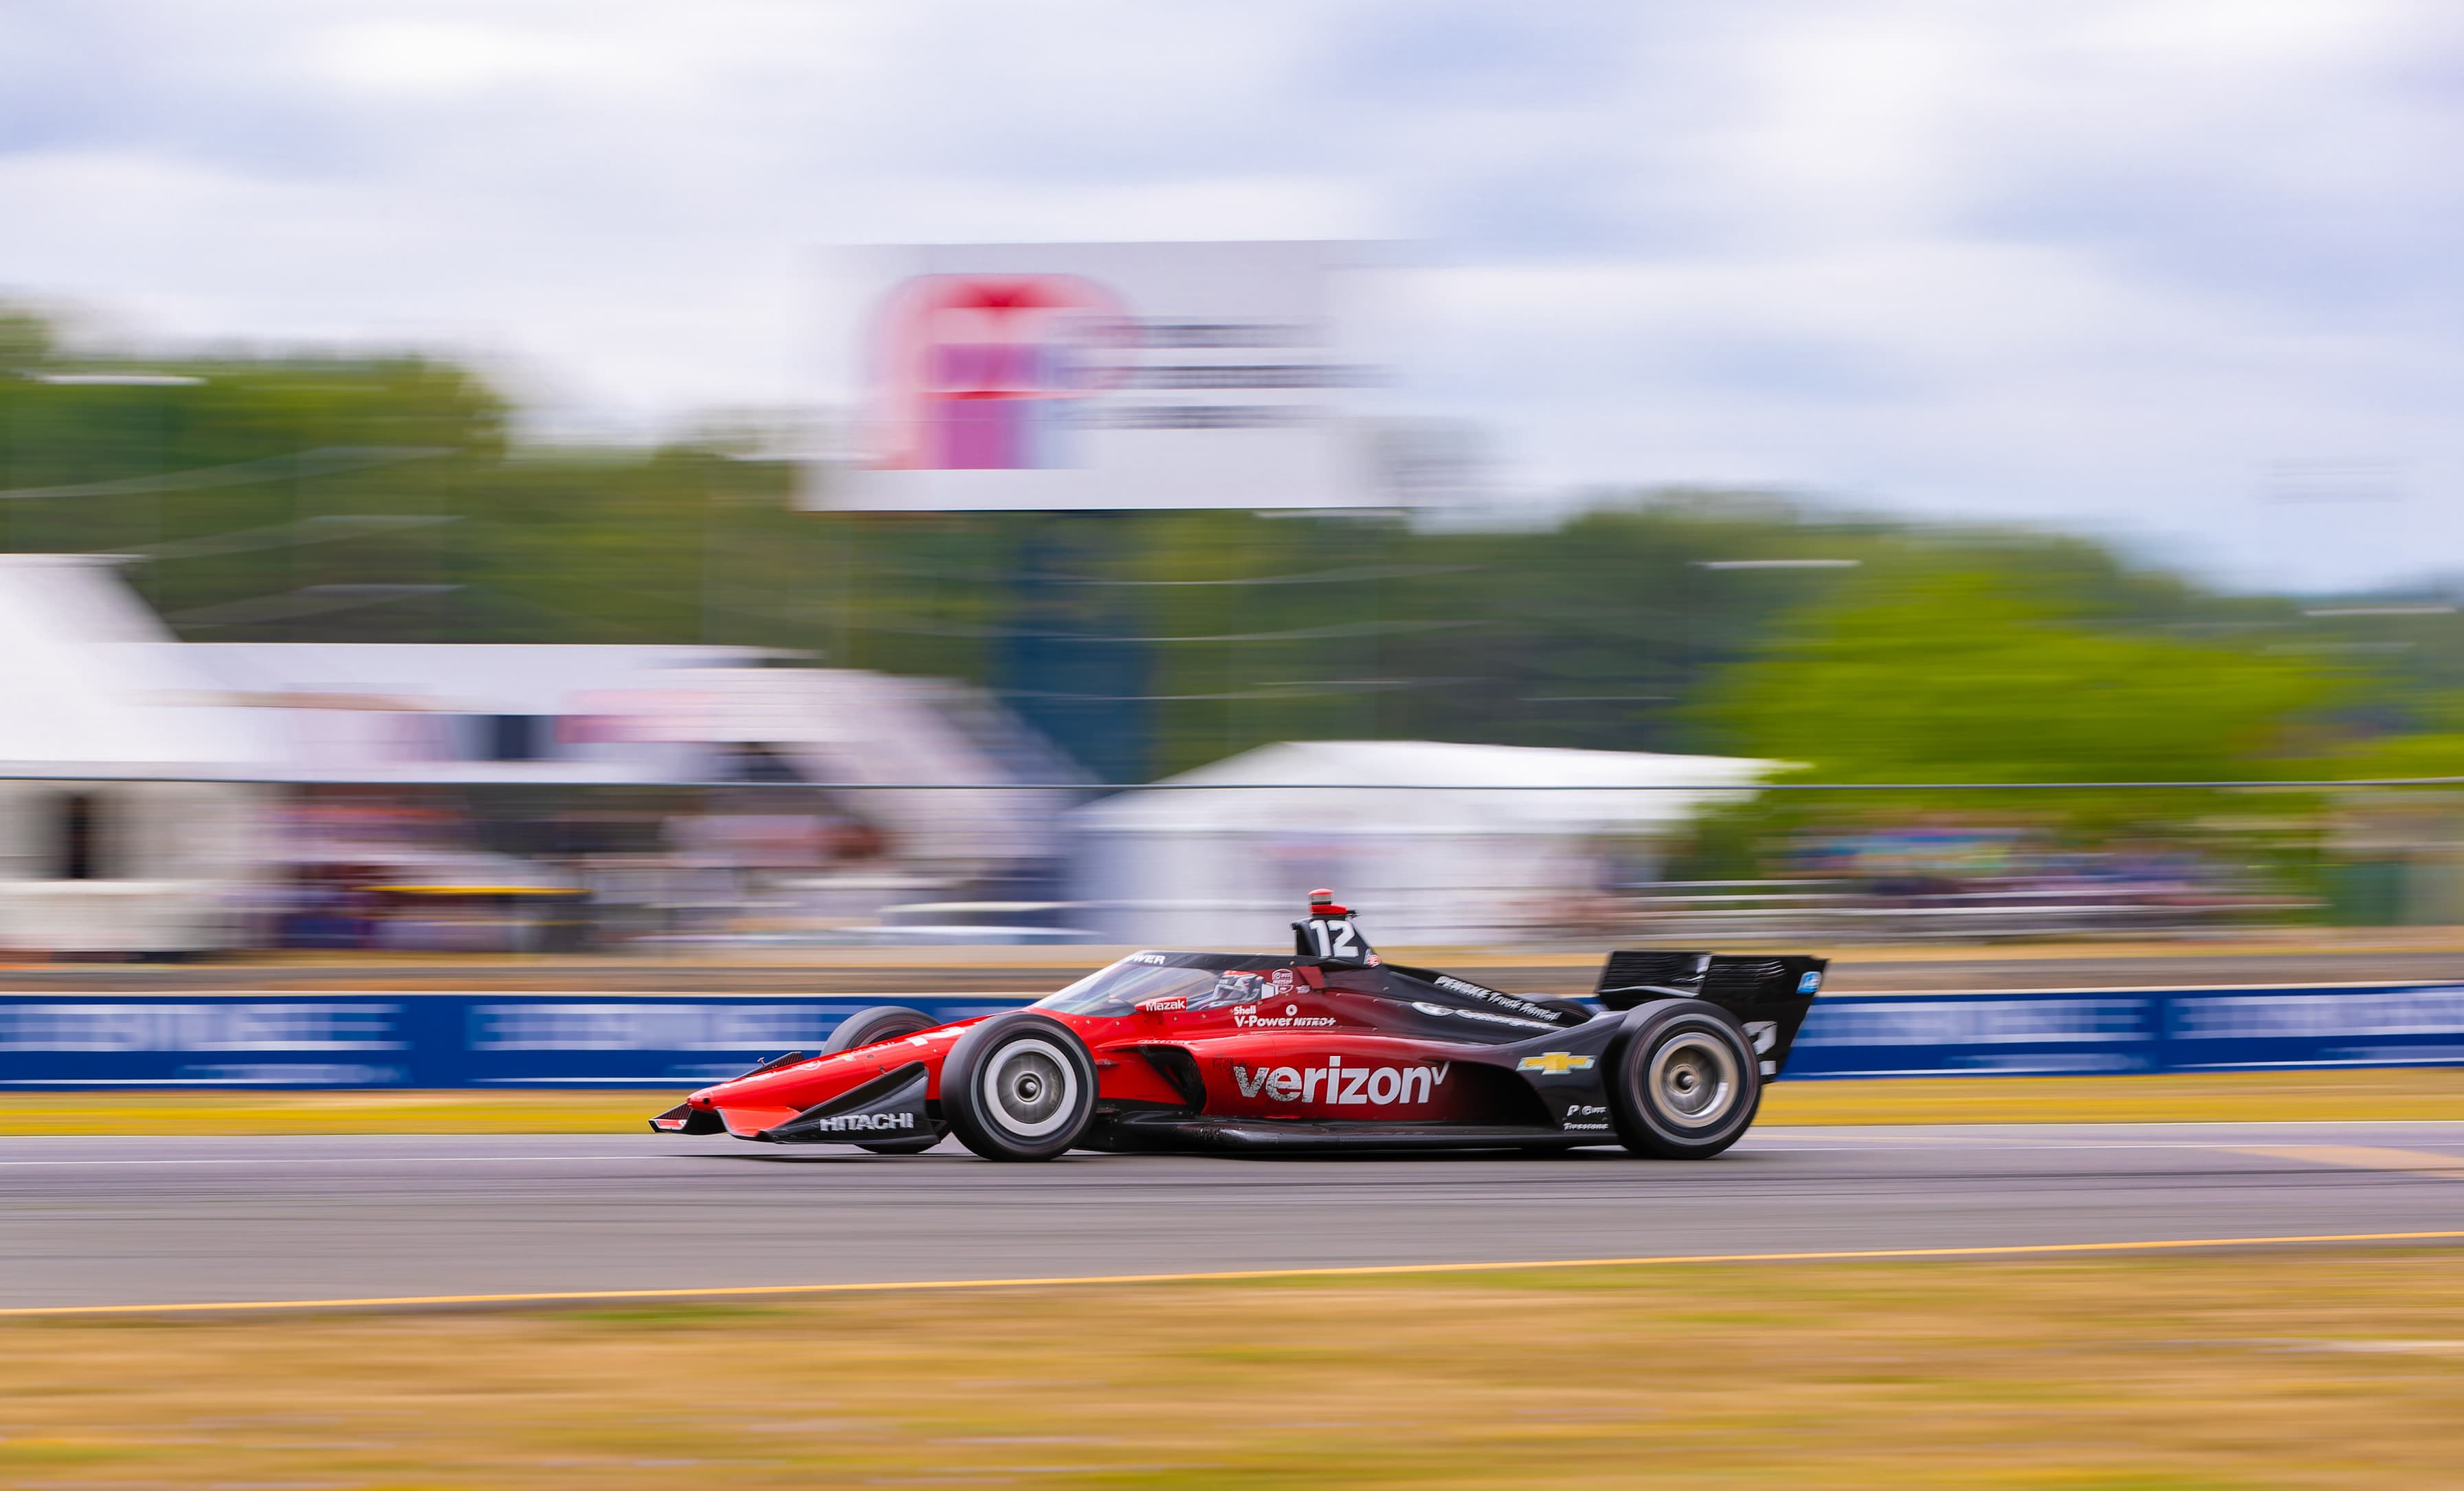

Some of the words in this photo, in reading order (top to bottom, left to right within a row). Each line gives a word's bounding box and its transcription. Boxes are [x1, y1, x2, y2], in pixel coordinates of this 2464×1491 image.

[1309, 920, 1359, 958] 12
[1146, 999, 1186, 1012] Mazak
[1233, 1005, 1257, 1016] Shell
[1234, 1015, 1293, 1028] V-Power
[1232, 1056, 1432, 1105] verizon
[819, 1112, 914, 1131] HITACHI
